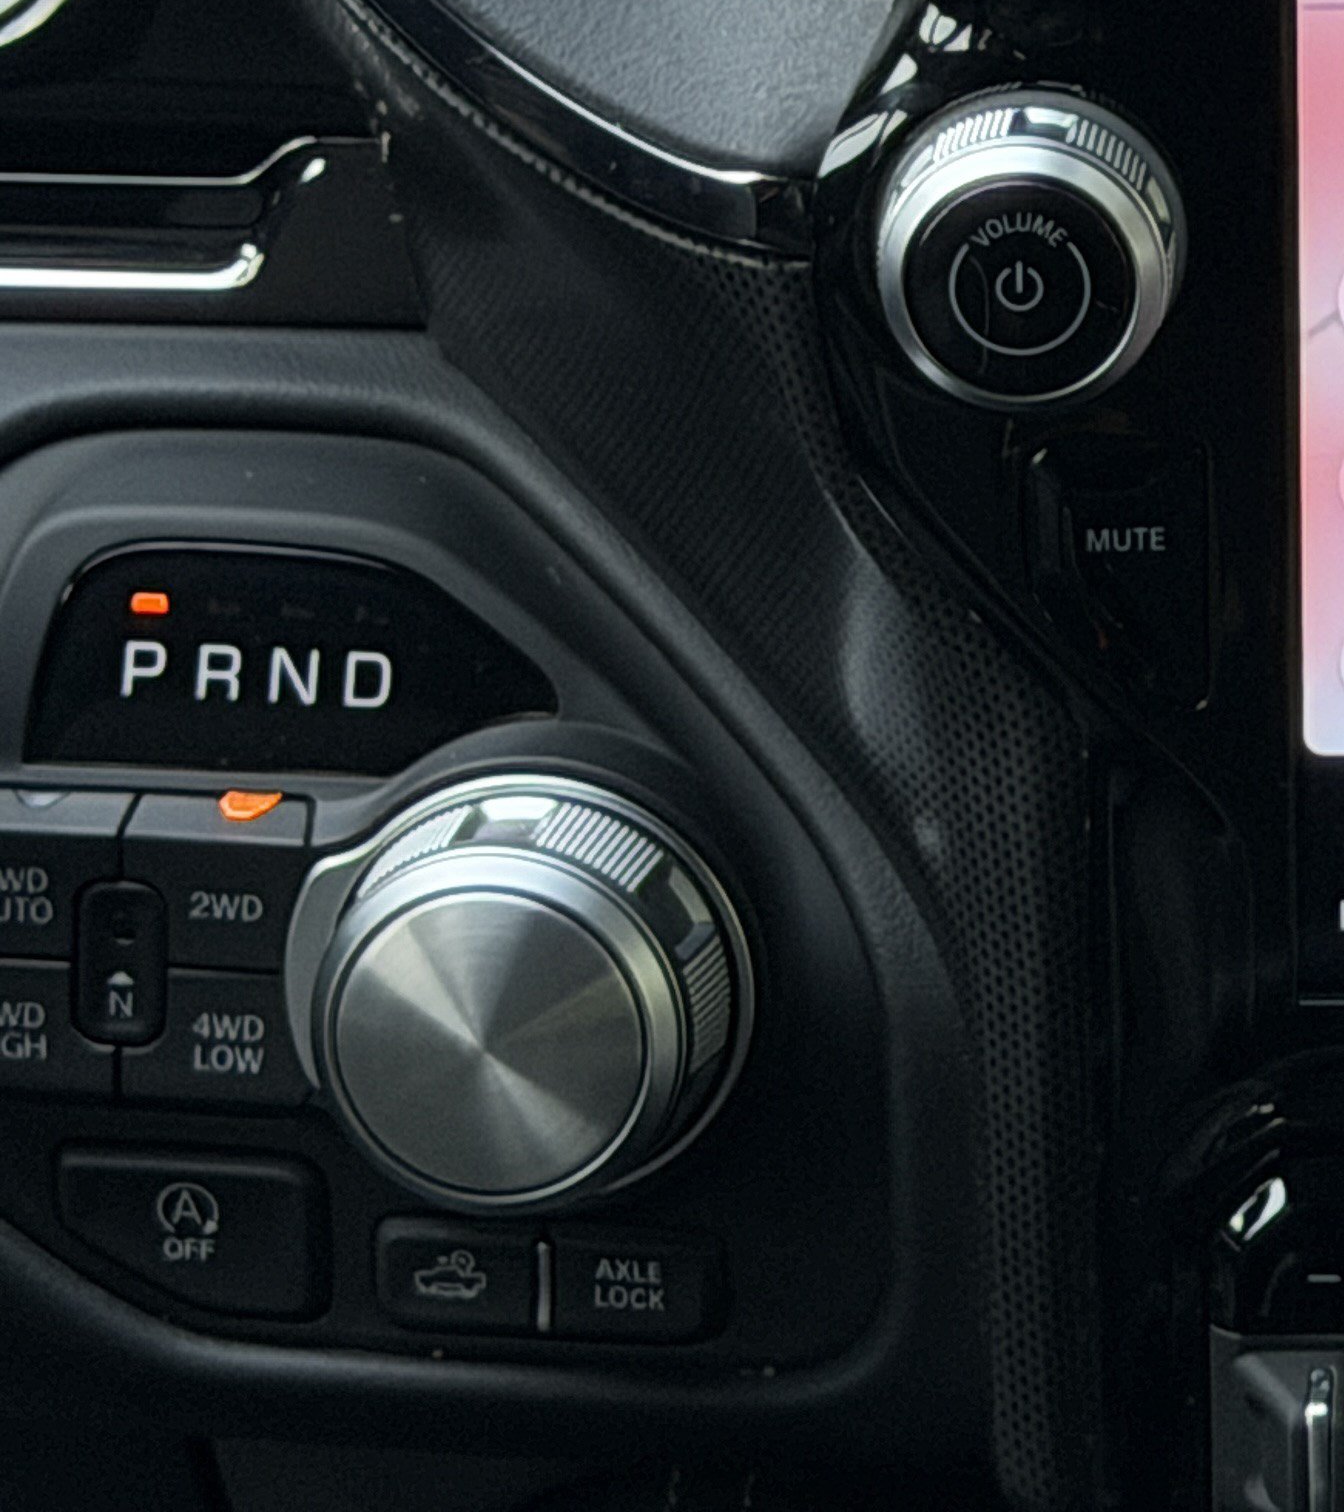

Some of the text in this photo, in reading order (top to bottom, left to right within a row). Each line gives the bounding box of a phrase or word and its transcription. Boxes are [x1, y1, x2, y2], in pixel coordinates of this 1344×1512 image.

[969, 213, 1069, 248] VOLUME
[1086, 527, 1166, 552] MUTE
[121, 641, 392, 708] P R N D
[189, 891, 264, 922] 2WD
[108, 991, 134, 1017] N
[192, 1012, 265, 1042] 4WD
[193, 1044, 265, 1074] LOW
[164, 1239, 216, 1261] OFF
[596, 1259, 662, 1284] AXLE
[595, 1285, 665, 1312] LOCK
